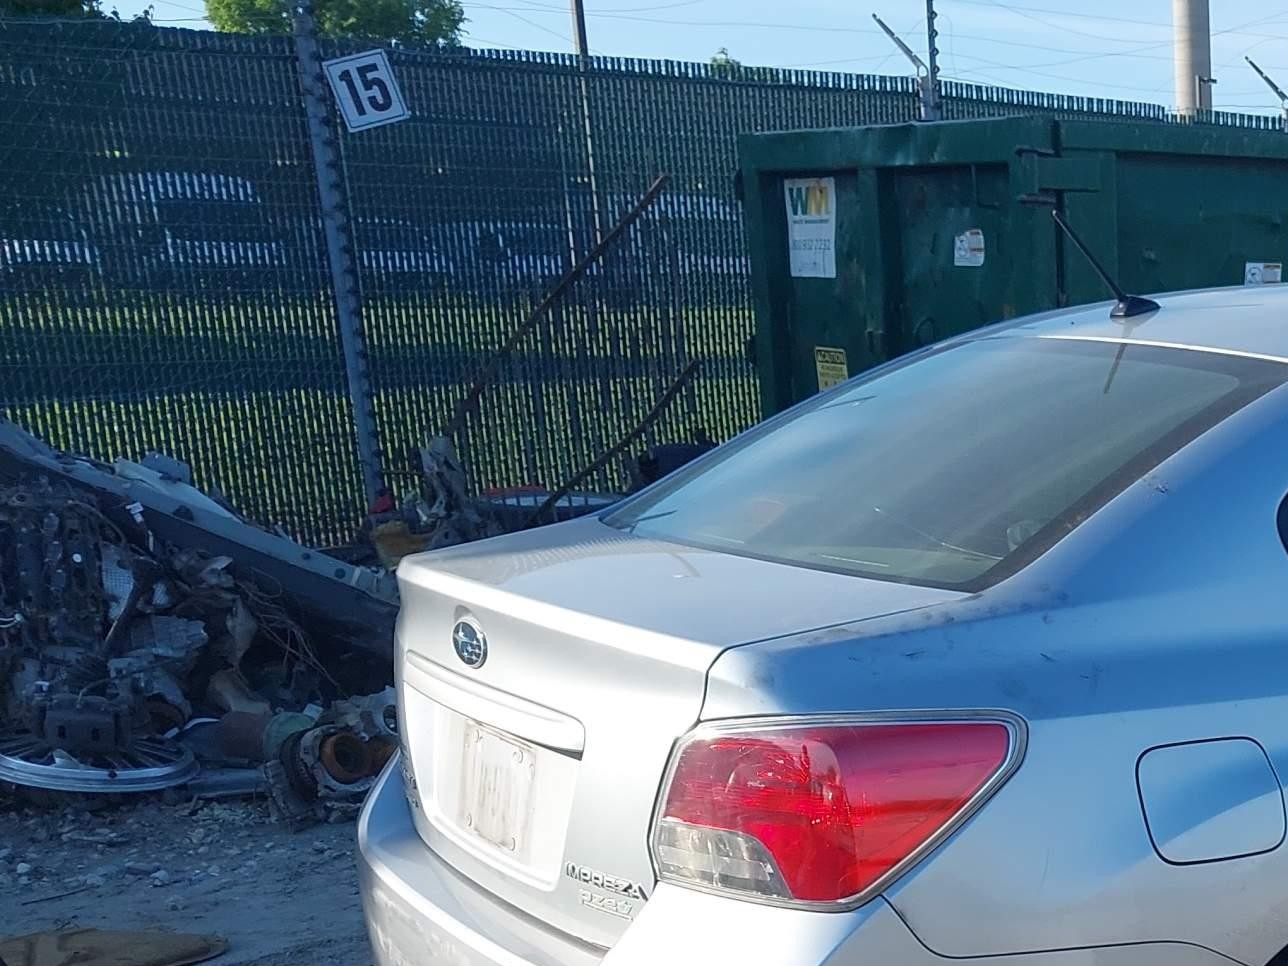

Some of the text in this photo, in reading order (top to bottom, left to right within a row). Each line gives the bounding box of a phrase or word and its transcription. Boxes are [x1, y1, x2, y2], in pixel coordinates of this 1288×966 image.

[338, 62, 393, 117] 15
[788, 186, 830, 216] WM
[565, 860, 649, 902] IMPREZA
